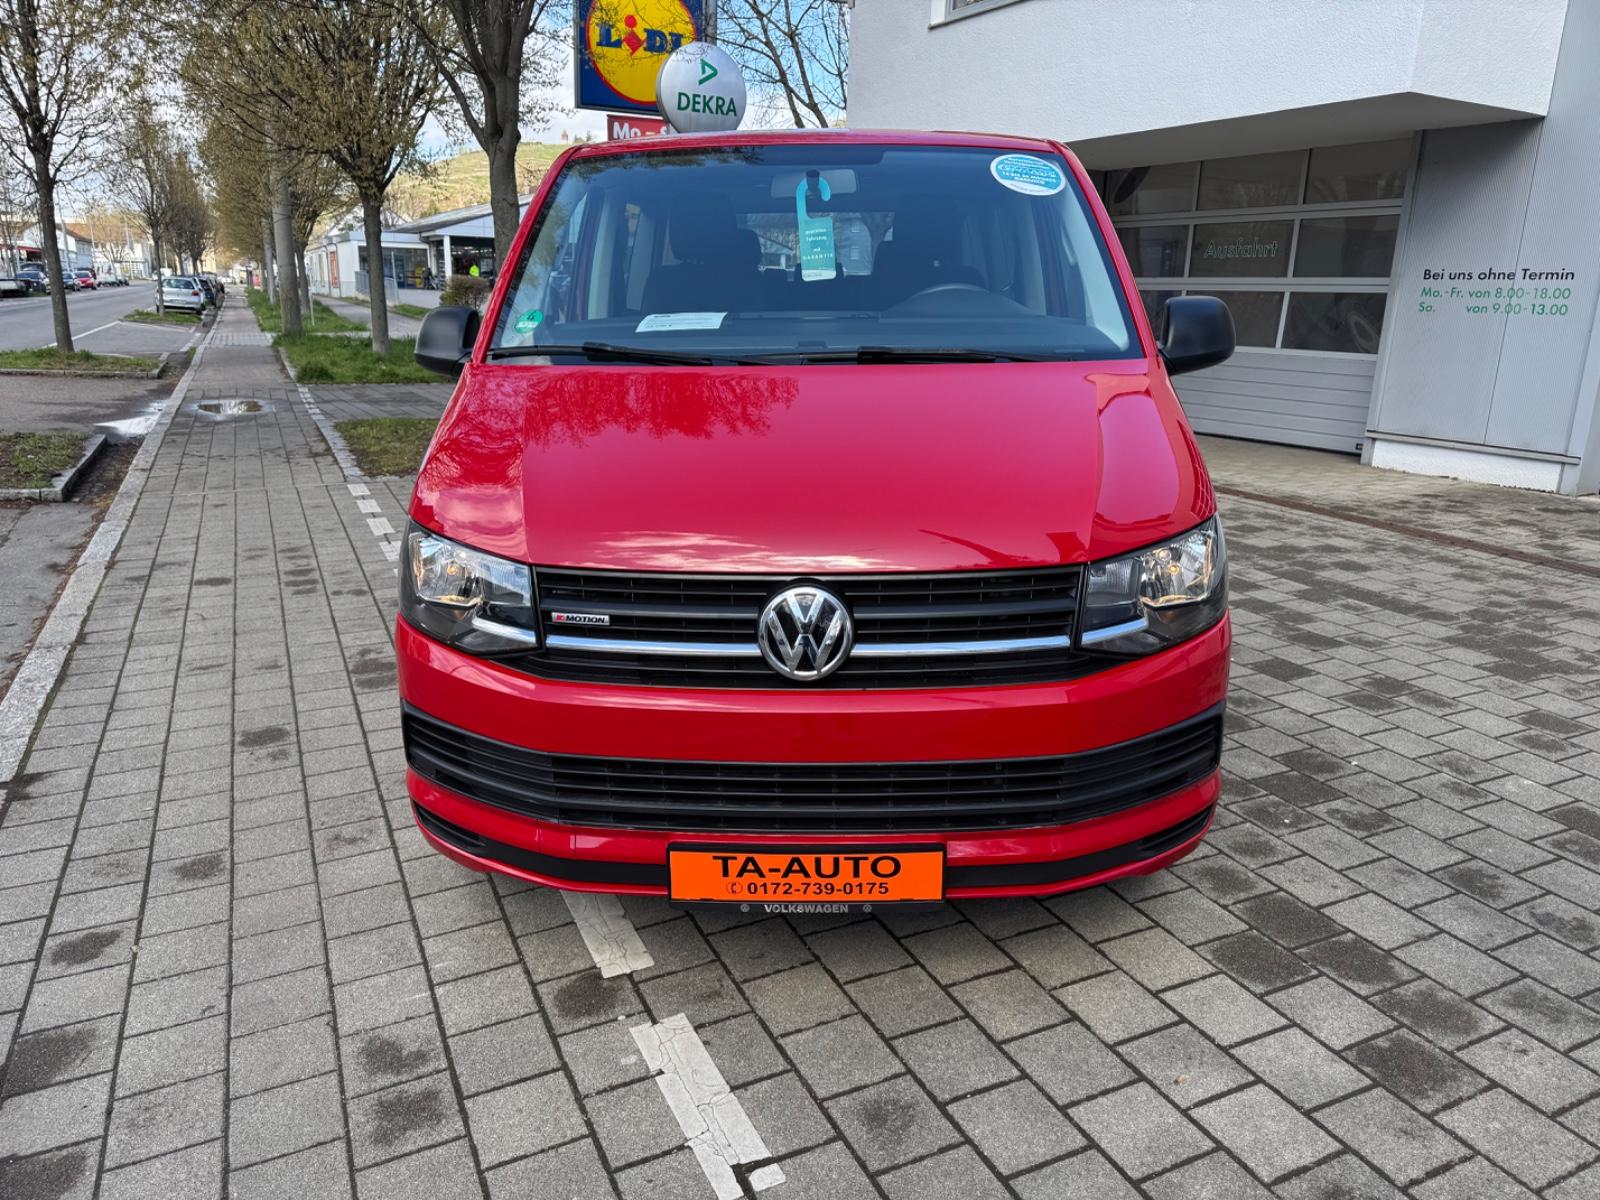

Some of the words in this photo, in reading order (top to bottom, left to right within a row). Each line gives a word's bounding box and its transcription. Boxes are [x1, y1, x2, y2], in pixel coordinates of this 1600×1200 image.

[677, 92, 737, 117] DEKRA
[613, 121, 642, 139] Mo
[1203, 237, 1279, 259] Ausfahrt
[1423, 268, 1446, 281] Bei
[1449, 272, 1473, 281] uns
[1477, 267, 1516, 281] ohne
[1521, 268, 1575, 281] Termin
[1468, 289, 1491, 299] von
[1466, 304, 1488, 314] von
[712, 855, 902, 879] TA-AUTO
[746, 882, 890, 896] 0172-739-0175
[764, 903, 849, 914] VOLKSWAGEN
